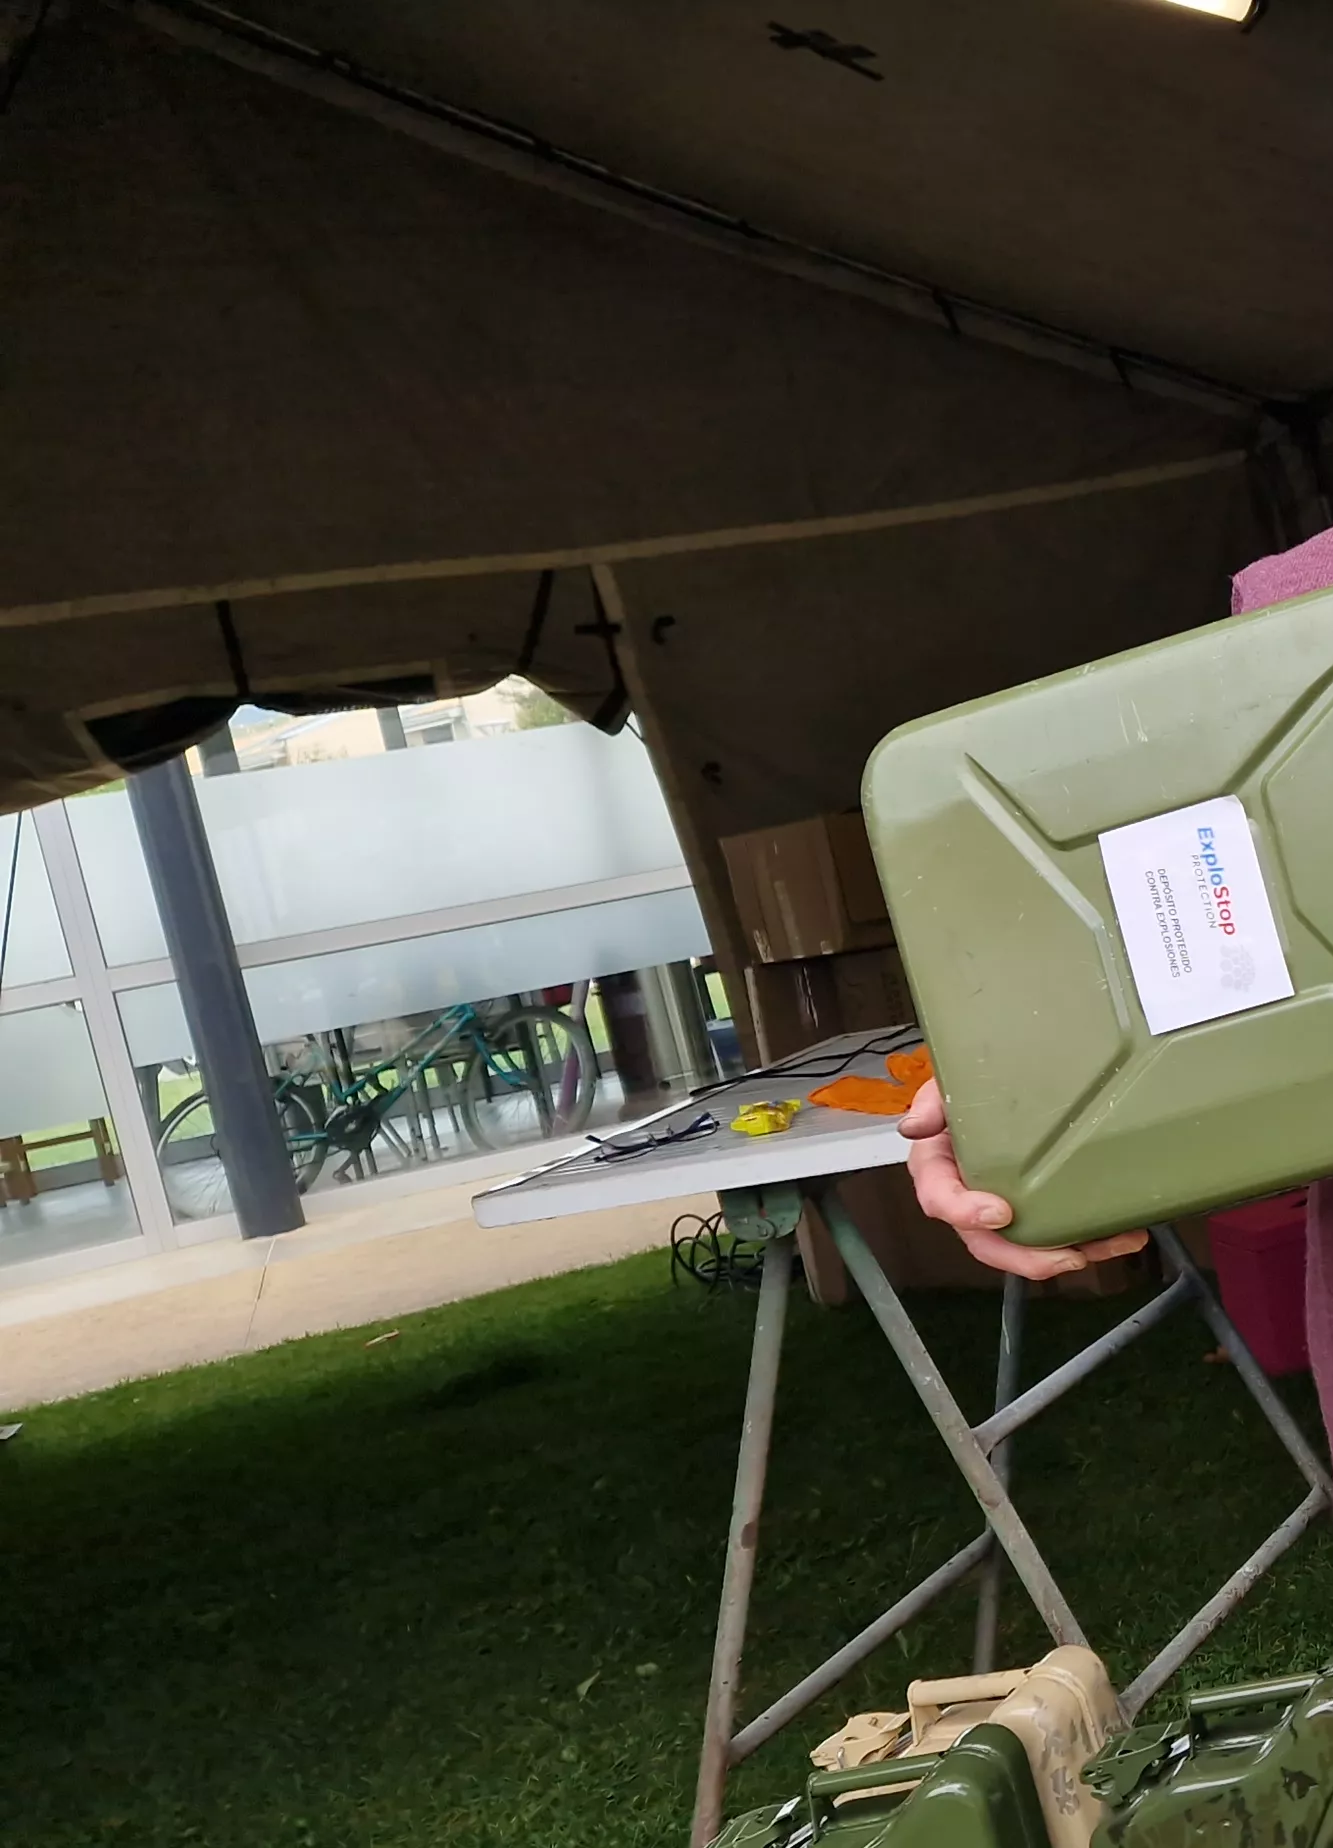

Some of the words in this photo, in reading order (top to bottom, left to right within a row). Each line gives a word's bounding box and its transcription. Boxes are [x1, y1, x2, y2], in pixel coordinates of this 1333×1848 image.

[1145, 870, 1162, 910] CONTRA
[1156, 912, 1181, 978] EXPLOSIONES
[1157, 868, 1177, 916] DEPÓSITO
[1171, 918, 1192, 973] PROTEGIDO
[1191, 854, 1217, 929] PROTECTION
[1197, 827, 1236, 935] ExploStop
